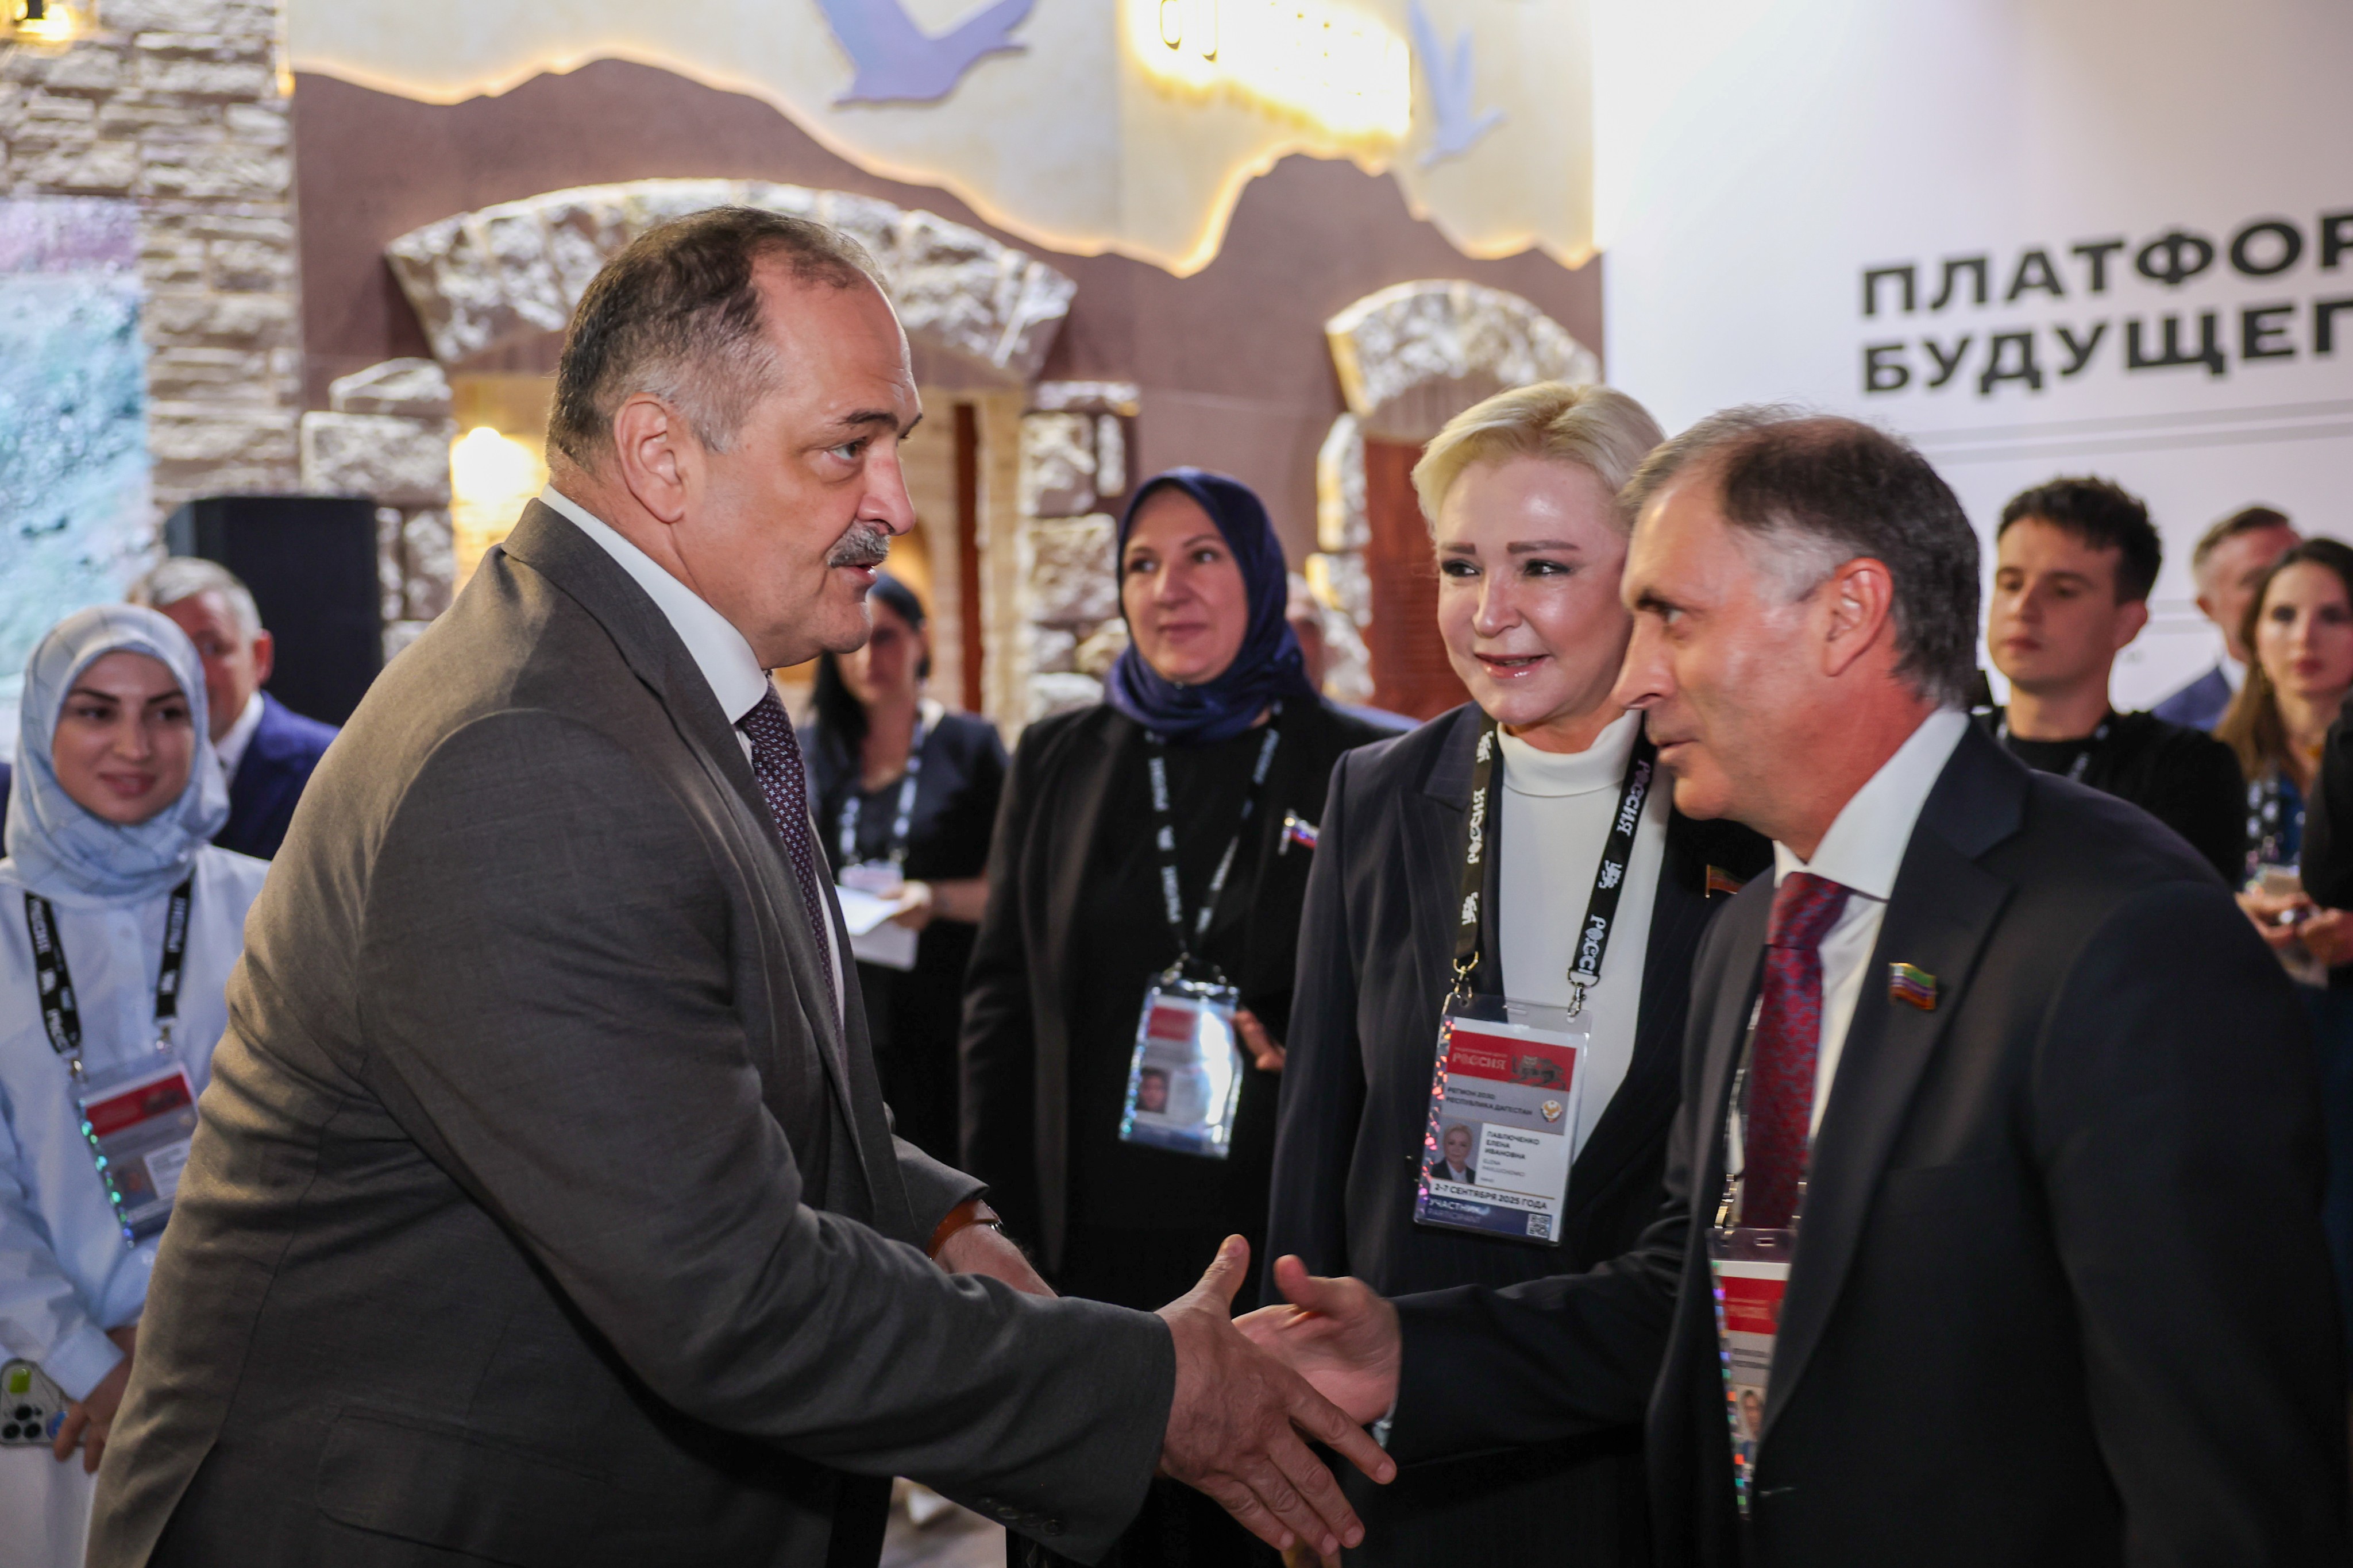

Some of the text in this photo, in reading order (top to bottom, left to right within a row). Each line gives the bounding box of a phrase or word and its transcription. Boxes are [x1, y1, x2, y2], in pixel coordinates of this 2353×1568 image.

[1452, 1052, 1507, 1070] РОССИЯ
[1449, 1186, 1497, 1200] СЕНТЯБРЯ
[1521, 1198, 1548, 1210] ГОДА
